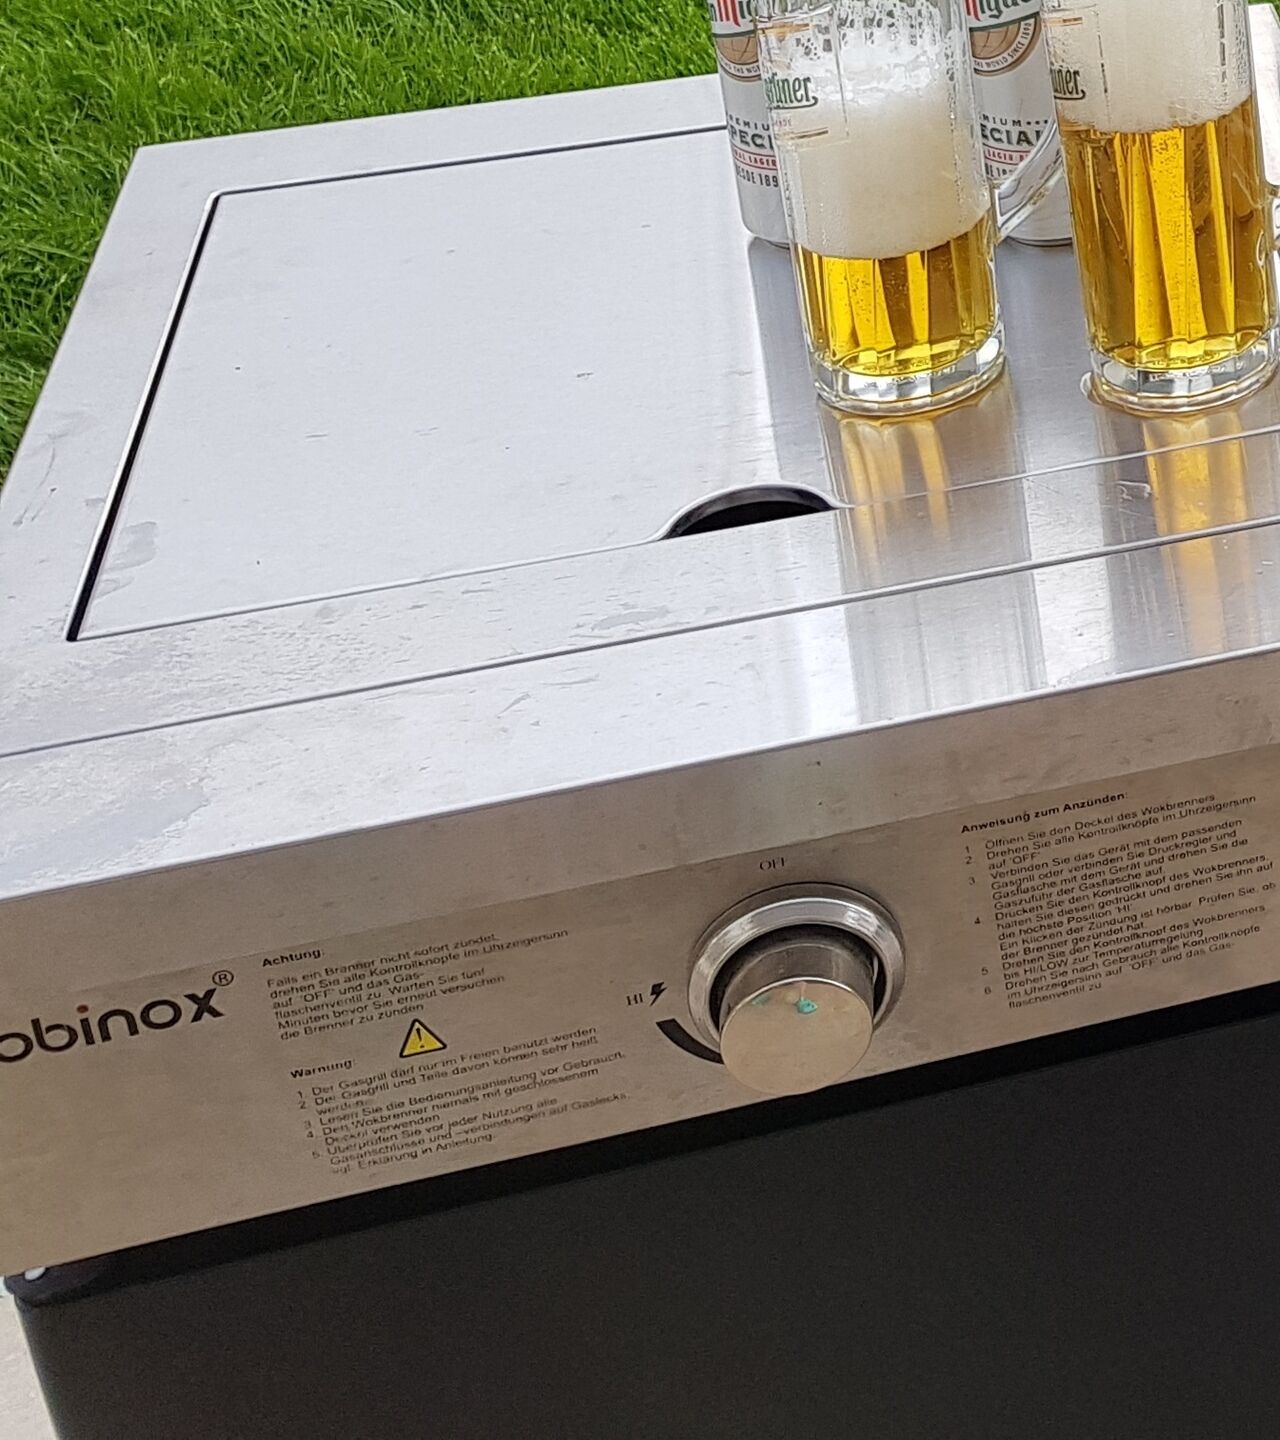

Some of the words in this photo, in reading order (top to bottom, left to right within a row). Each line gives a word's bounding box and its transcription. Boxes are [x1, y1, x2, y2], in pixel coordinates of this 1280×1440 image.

[960, 813, 1030, 834] Anweisung
[1033, 807, 1060, 818] zum
[1062, 791, 1128, 812] Anzünden:
[1048, 825, 1072, 836] den
[1116, 811, 1138, 822] des
[990, 862, 1049, 880] Verbinden
[1050, 857, 1071, 867] Sie
[1072, 852, 1094, 862] das
[1098, 843, 1130, 857] Gerät
[1132, 839, 1150, 849] mit
[1152, 833, 1178, 845] dem
[1180, 819, 1242, 841] passenden
[1038, 868, 1064, 881] oder
[1126, 851, 1145, 861] Sie
[1216, 829, 1237, 841] und
[1060, 875, 1078, 886] mit
[1080, 870, 1106, 881] dem
[1143, 855, 1164, 868] und
[1166, 846, 1207, 862] drehen
[1210, 843, 1228, 853] Sie
[1230, 838, 1248, 848] die
[759, 857, 787, 871] OFF
[1046, 900, 1064, 910] Sie
[1068, 894, 1090, 905] den
[1092, 875, 1166, 899] Kontrollknopf
[1168, 872, 1190, 882] des
[1078, 872, 1142, 892] Gasflasche
[1149, 884, 1170, 897] und
[1173, 876, 1212, 891] drehen
[338, 983, 362, 995] und
[626, 993, 644, 1006] HI
